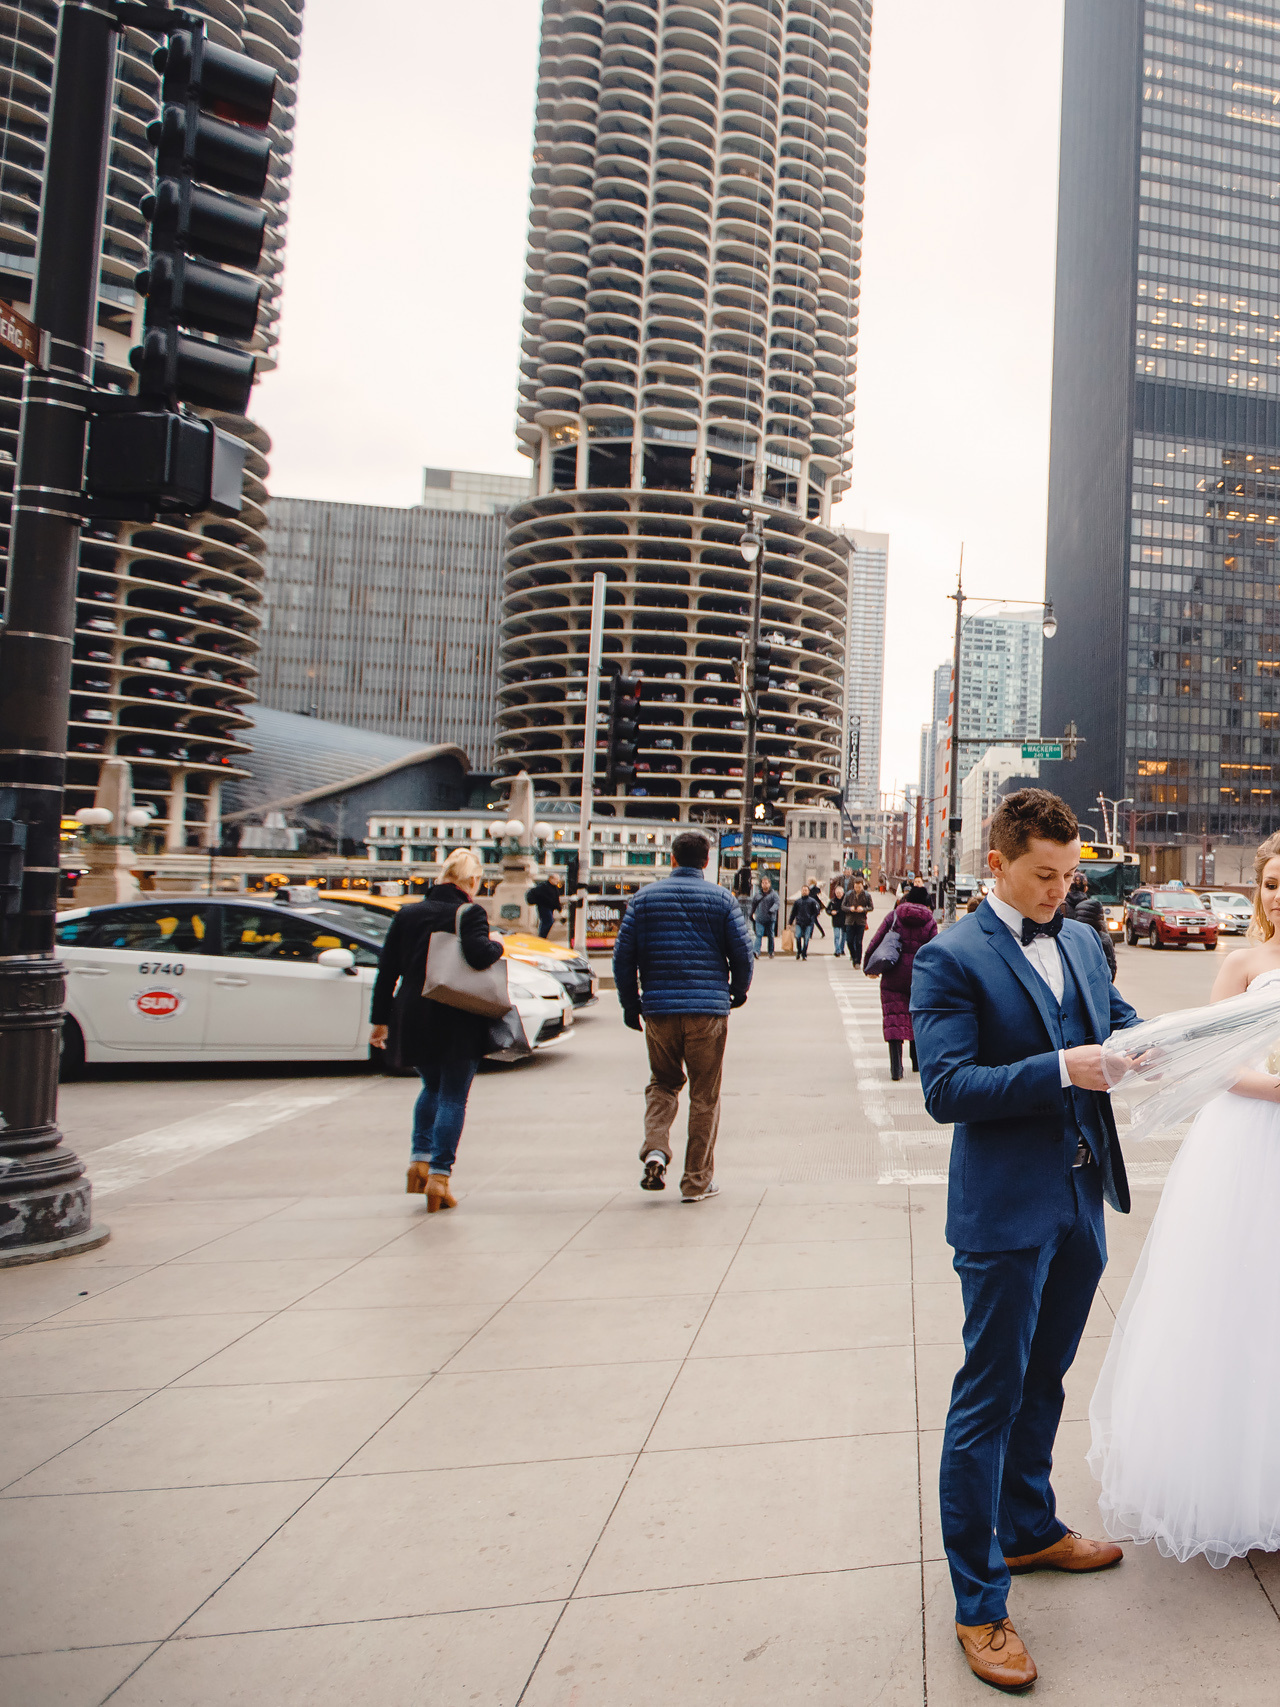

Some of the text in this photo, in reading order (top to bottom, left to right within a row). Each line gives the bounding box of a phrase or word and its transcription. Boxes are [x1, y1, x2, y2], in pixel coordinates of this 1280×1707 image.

[0, 318, 23, 349] ERG
[849, 731, 858, 779] CHICAGO
[586, 906, 620, 920] PERSTAR
[139, 962, 185, 976] 6740
[139, 996, 176, 1010] SUN
